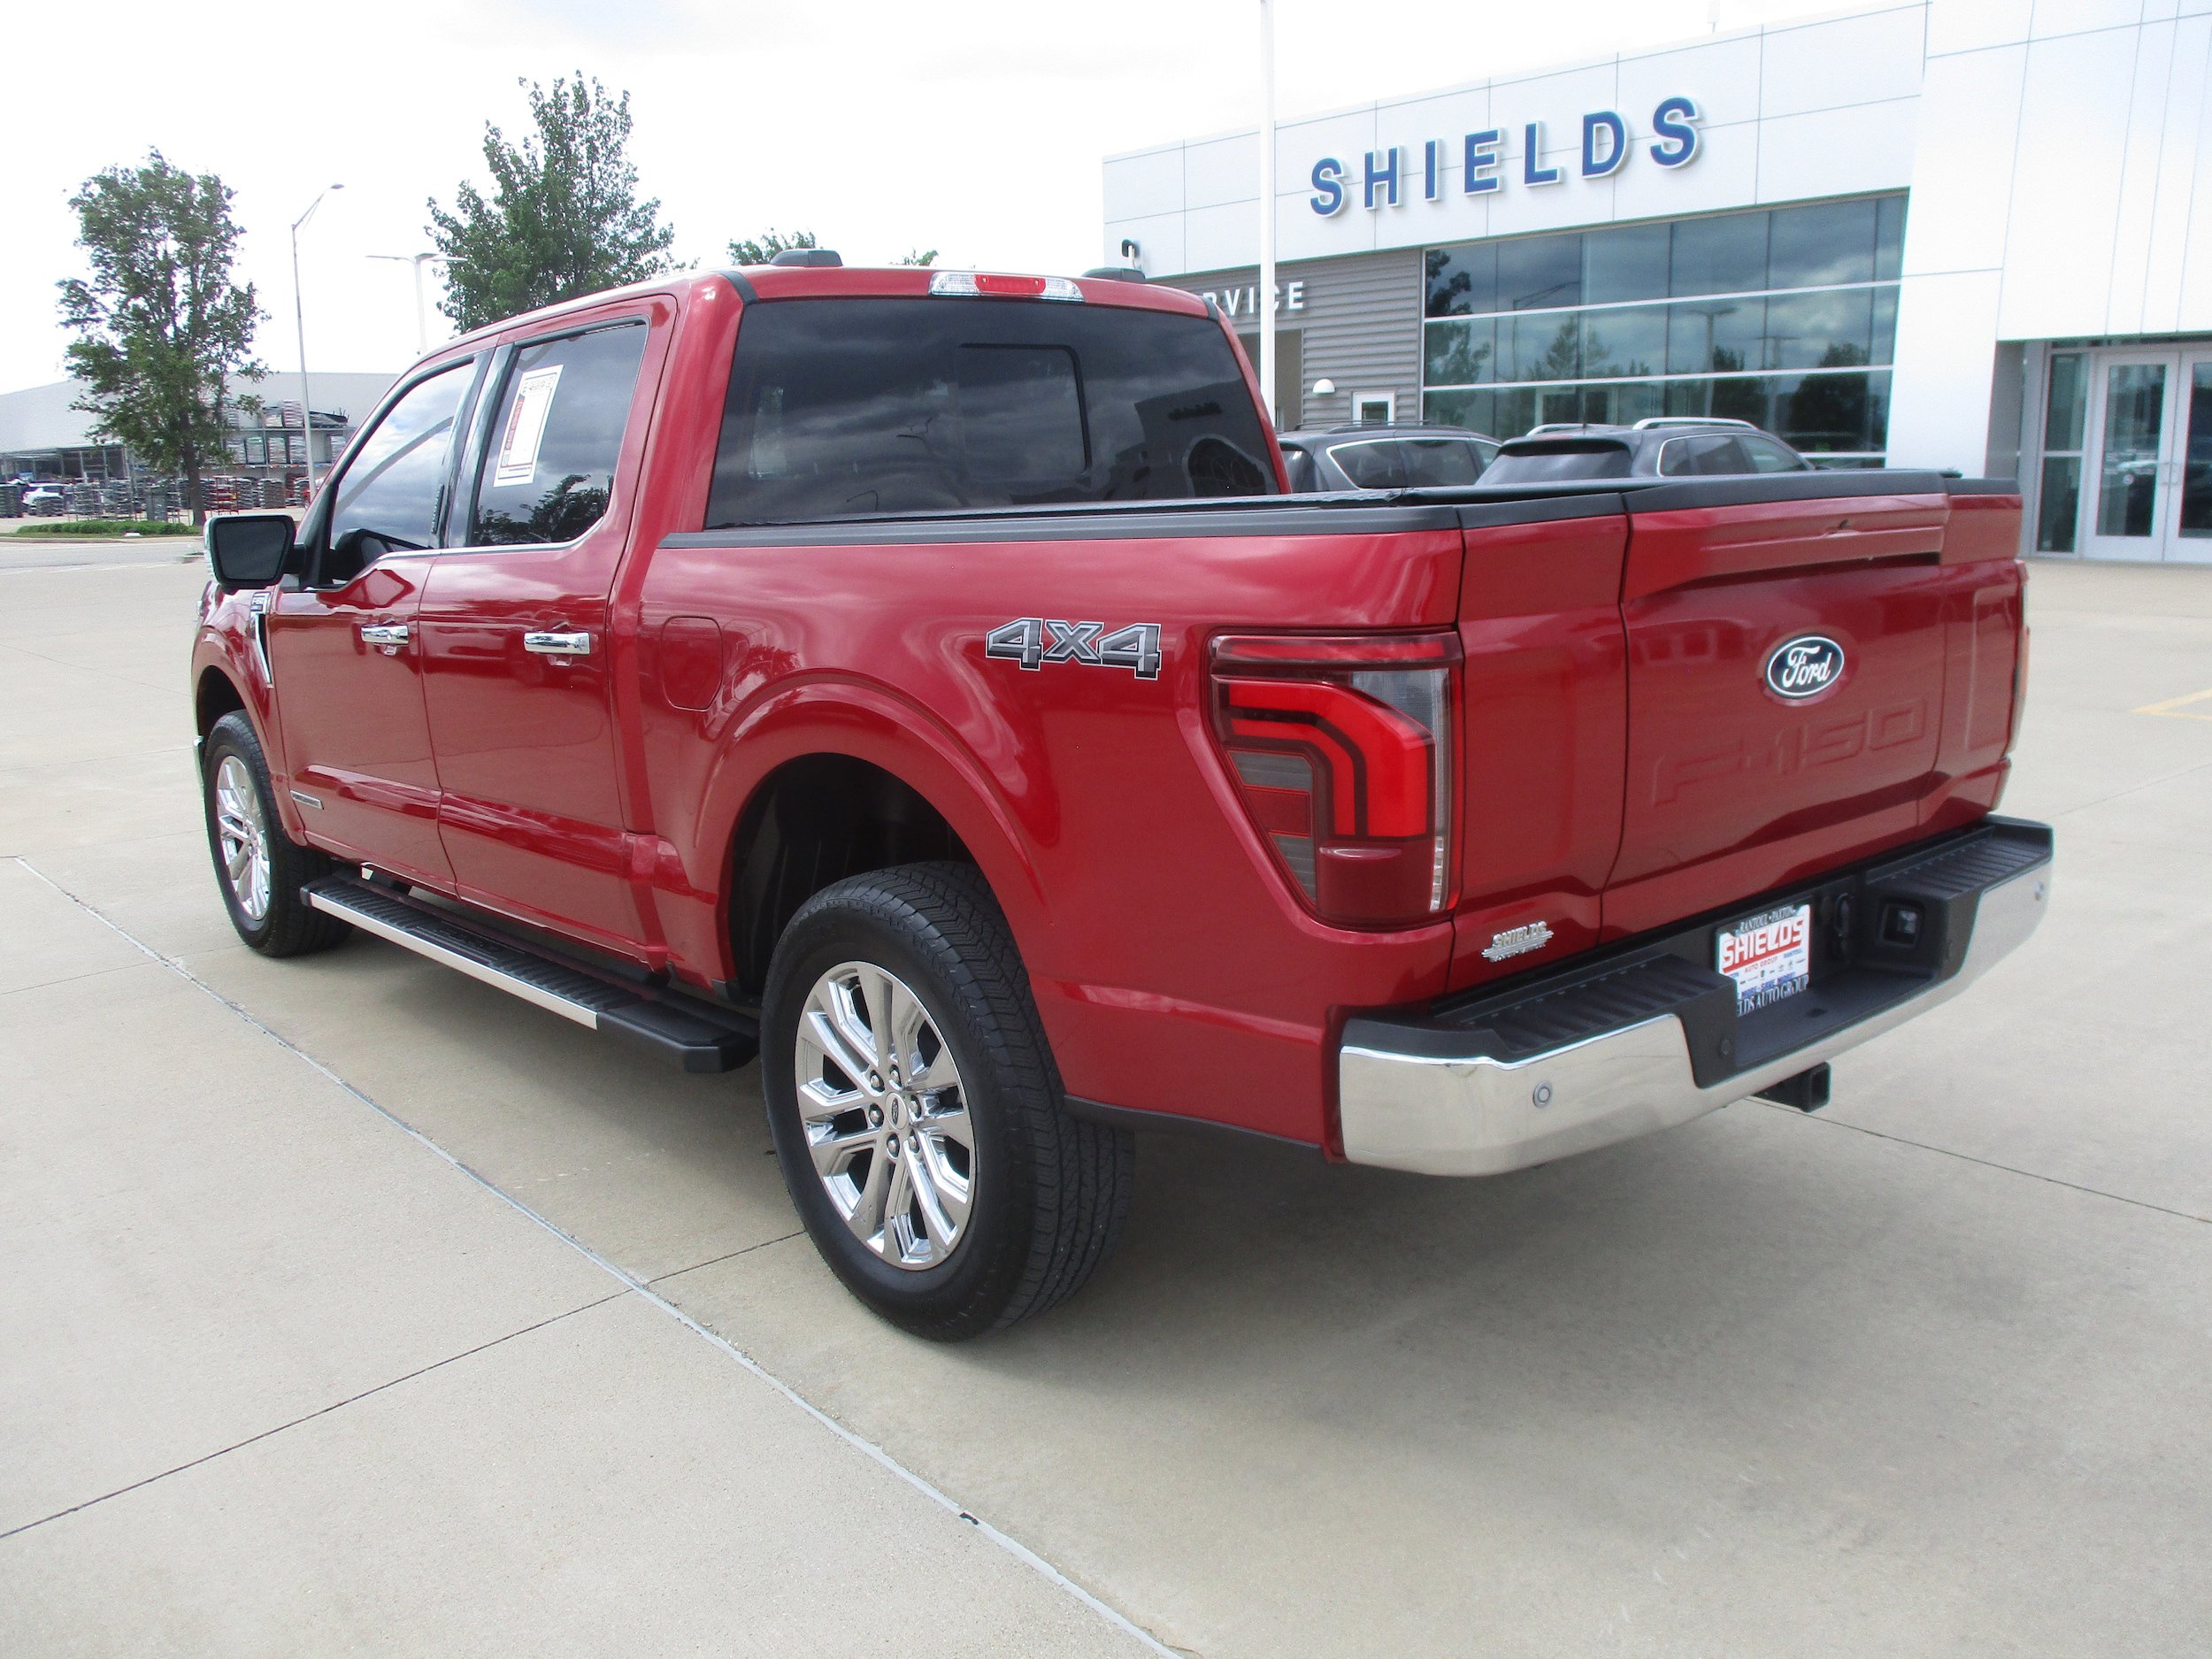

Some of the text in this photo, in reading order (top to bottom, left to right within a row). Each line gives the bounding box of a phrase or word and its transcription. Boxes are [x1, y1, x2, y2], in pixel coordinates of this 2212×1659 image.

[1310, 95, 1700, 217] SHIELDS
[1782, 645, 1833, 688] Ford
[1653, 698, 1927, 807] F-150
[1492, 920, 1547, 948] SHIELDS
[1722, 918, 1804, 966] SHIELDS
[1745, 956, 1778, 972] AUTO GROUP
[1755, 986, 1779, 1009] AUTO
[1780, 974, 1809, 999] GROUP
